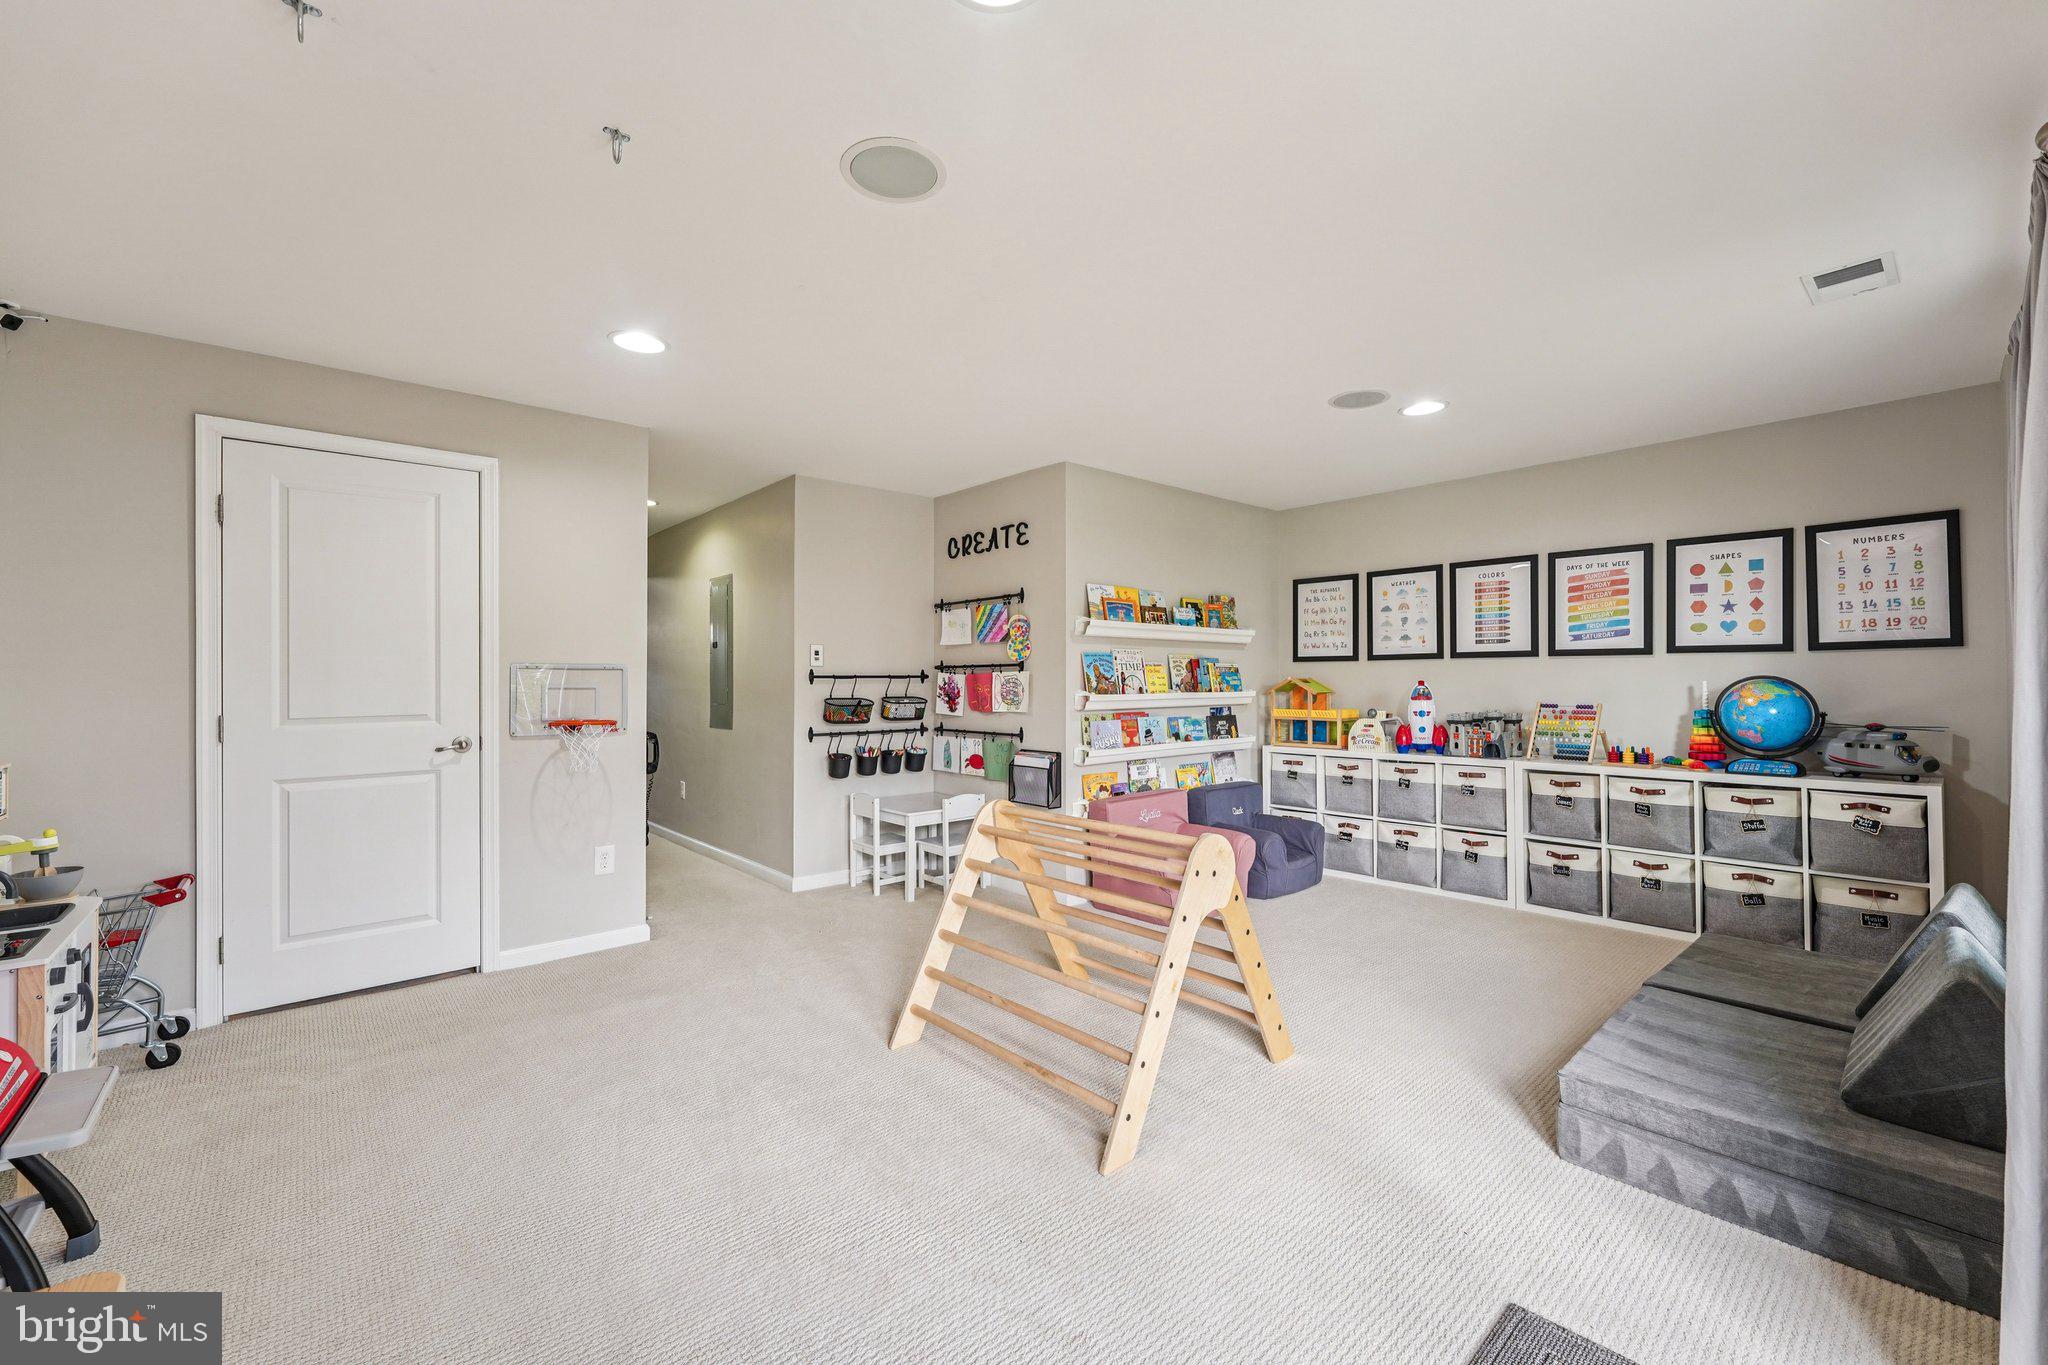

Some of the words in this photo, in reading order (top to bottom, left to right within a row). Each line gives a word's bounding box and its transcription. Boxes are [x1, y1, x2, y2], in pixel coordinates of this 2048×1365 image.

[948, 522, 1030, 559] CREATE
[1853, 534, 1905, 544] NUMBERS
[1710, 552, 1742, 560] SHAPES
[1838, 550, 1843, 560] 1
[1861, 548, 1869, 557] 2
[1887, 546, 1896, 555] 3
[1913, 544, 1923, 552] 4
[1838, 567, 1846, 575] 5
[1863, 565, 1871, 573] 6
[1889, 562, 1896, 571] 7
[1914, 560, 1924, 569] 8
[1478, 571, 1505, 579] COLORS
[1584, 571, 1610, 579] SUNDAY
[1584, 581, 1611, 590] MONDAY
[1837, 583, 1846, 592] 9
[1859, 581, 1874, 590] 10
[1884, 579, 1898, 589] 11
[1910, 578, 1925, 587] 12
[1583, 591, 1612, 600] TUESDAY
[1578, 601, 1616, 610] WEDNESDAY
[1838, 601, 1854, 610] 13
[1862, 599, 1877, 609] 14
[1886, 598, 1901, 607] 15
[1911, 596, 1926, 606] 16
[1581, 610, 1614, 619] THURSDAY
[1586, 621, 1608, 629] FRIDAY
[1839, 620, 1851, 629] 17
[1861, 618, 1877, 628] 18
[1886, 617, 1901, 627] 19
[1909, 616, 1928, 626] 20
[1582, 631, 1615, 640] SATURDAY
